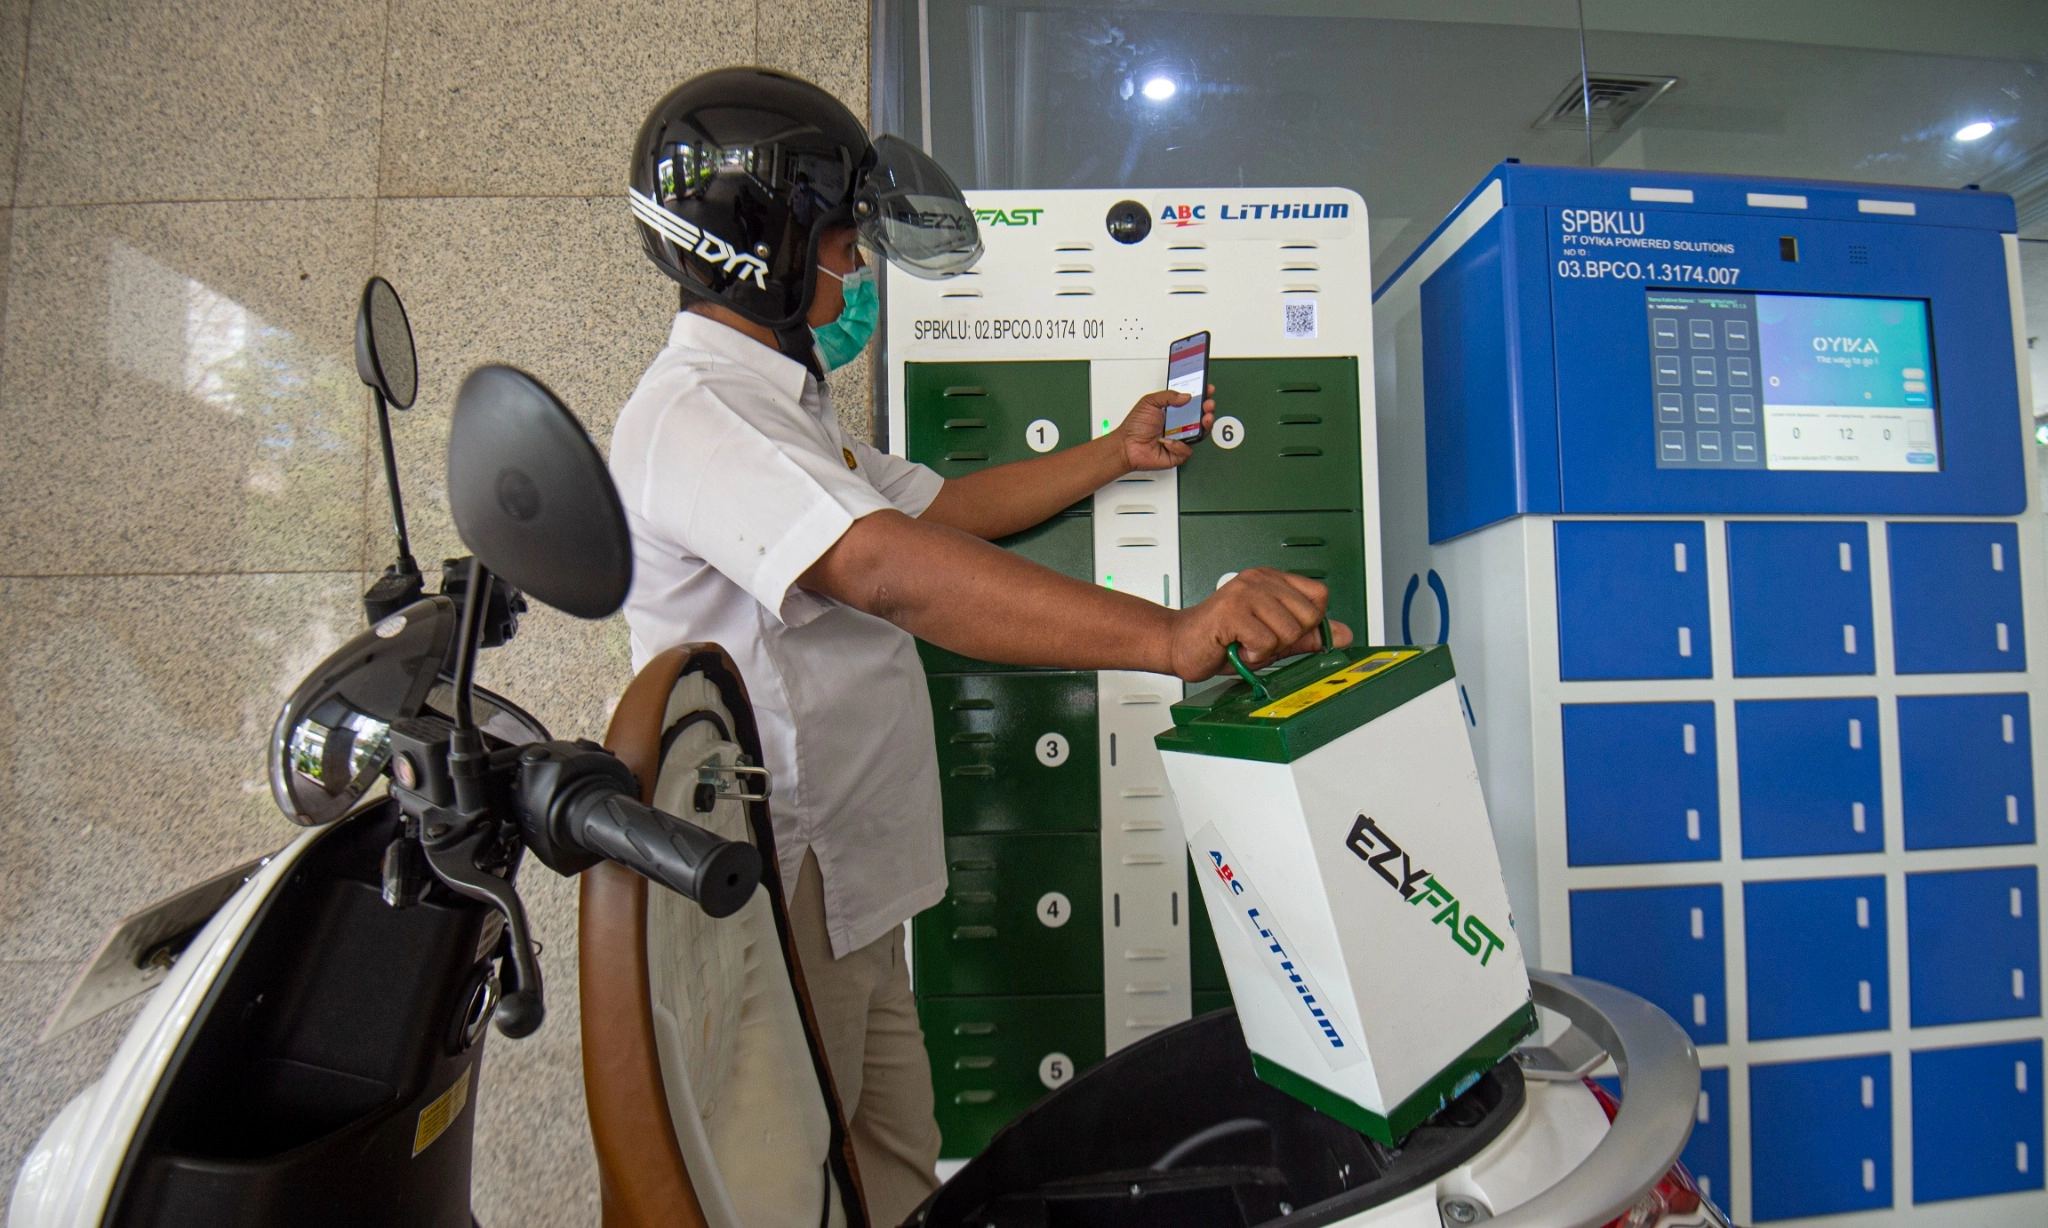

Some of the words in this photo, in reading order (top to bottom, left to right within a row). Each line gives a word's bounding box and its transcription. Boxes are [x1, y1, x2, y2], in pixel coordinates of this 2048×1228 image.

[1160, 205, 1206, 220] ABC
[1561, 208, 1645, 236] SPBKLU
[1562, 235, 1577, 245] PT
[1580, 235, 1614, 247] OYIKA
[1615, 237, 1671, 250] POWERED
[1673, 240, 1735, 254] SOLUTIONS
[1557, 260, 1741, 285] 03.BPCO.1.3174.007
[914, 319, 971, 340] SPBKLU:
[974, 319, 1043, 340] 02.BPCO.0
[1046, 319, 1076, 339] 3174
[1083, 319, 1105, 338] 001
[1812, 336, 1880, 354] OYIKA
[1035, 426, 1045, 444] 1
[1222, 424, 1234, 442] 6
[1839, 428, 1854, 441] 12
[1046, 740, 1059, 758] 3
[1208, 850, 1244, 896] ABC
[1346, 813, 1505, 968] EZYFAST
[1046, 900, 1059, 918] 4
[1050, 1061, 1063, 1080] 5
